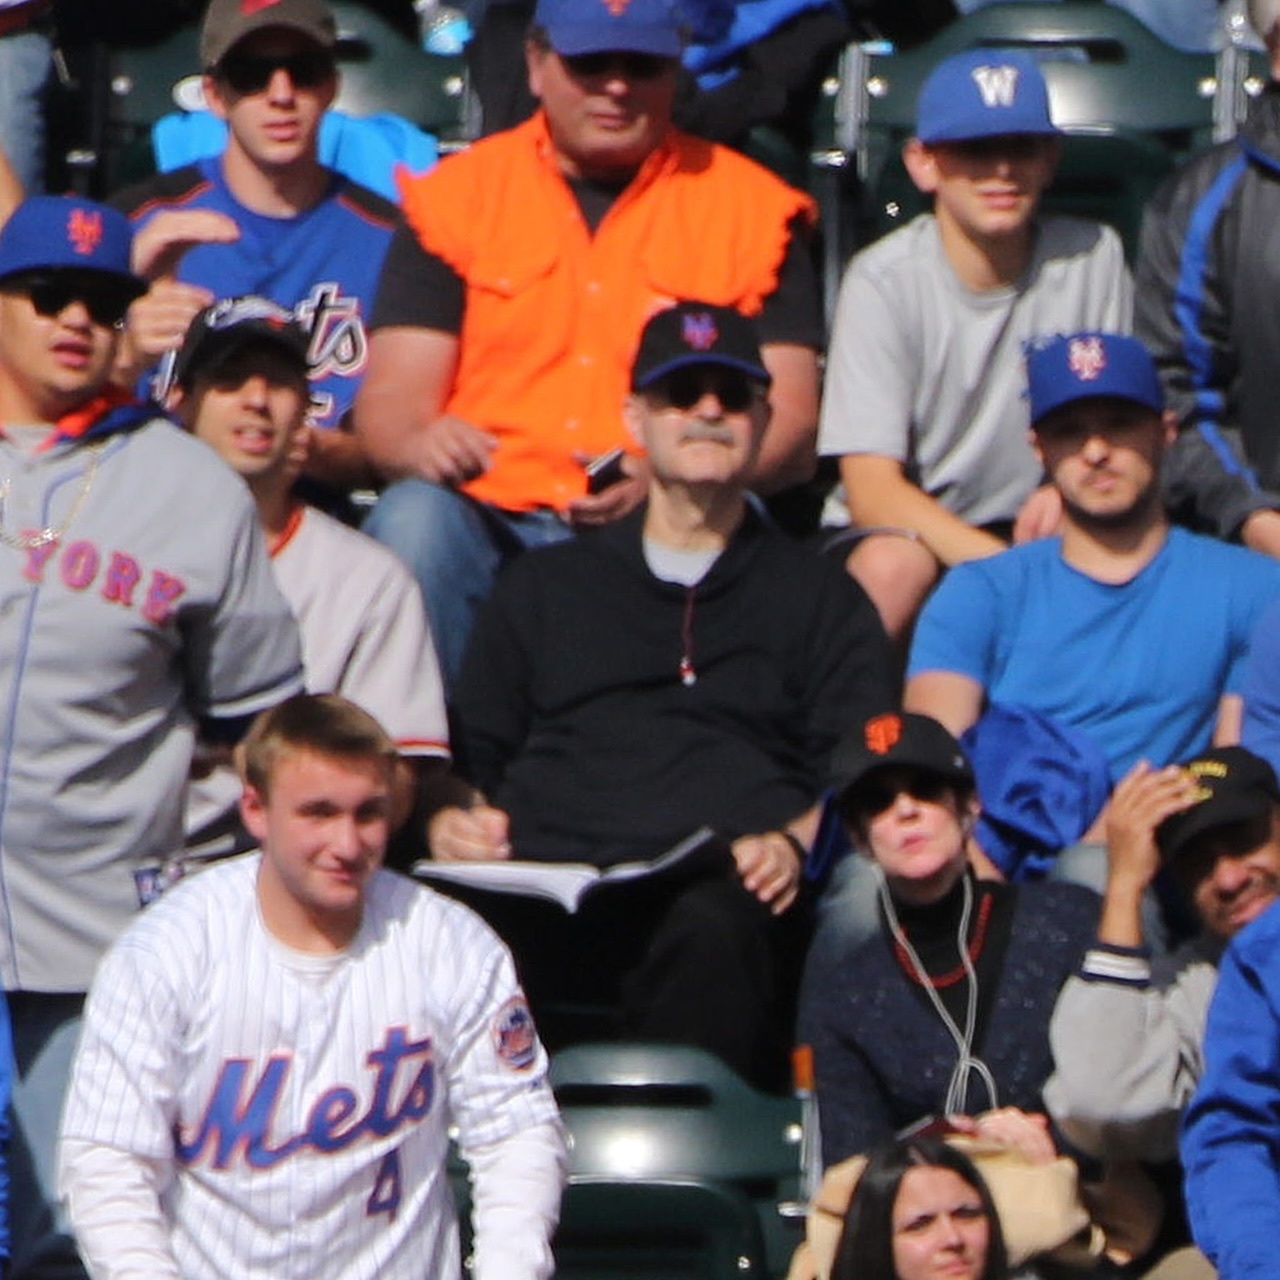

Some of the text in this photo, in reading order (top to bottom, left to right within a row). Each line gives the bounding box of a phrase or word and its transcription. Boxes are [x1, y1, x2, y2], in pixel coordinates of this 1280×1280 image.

[971, 66, 1018, 108] W
[19, 528, 186, 628] YORK
[172, 1022, 436, 1172] Mets
[365, 1147, 402, 1224] 4
